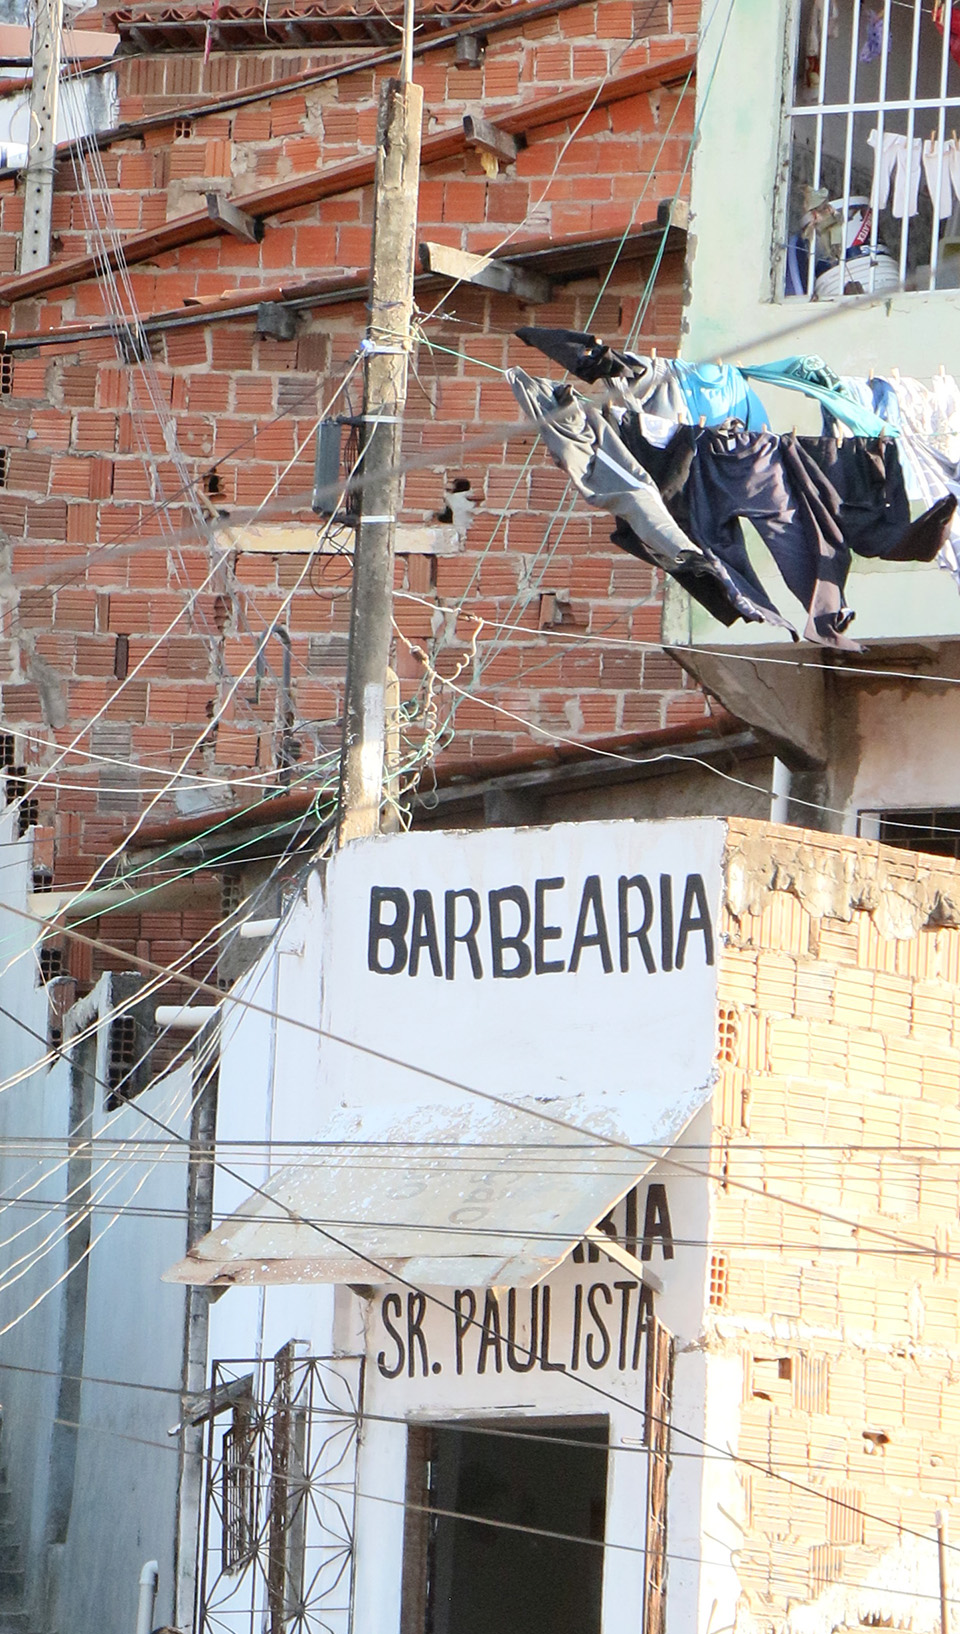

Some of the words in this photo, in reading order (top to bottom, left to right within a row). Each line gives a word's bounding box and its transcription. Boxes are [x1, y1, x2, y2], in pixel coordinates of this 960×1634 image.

[368, 873, 715, 981] BARBEARIA
[378, 1291, 442, 1379] SR.
[454, 1280, 656, 1376] PAULISTA
